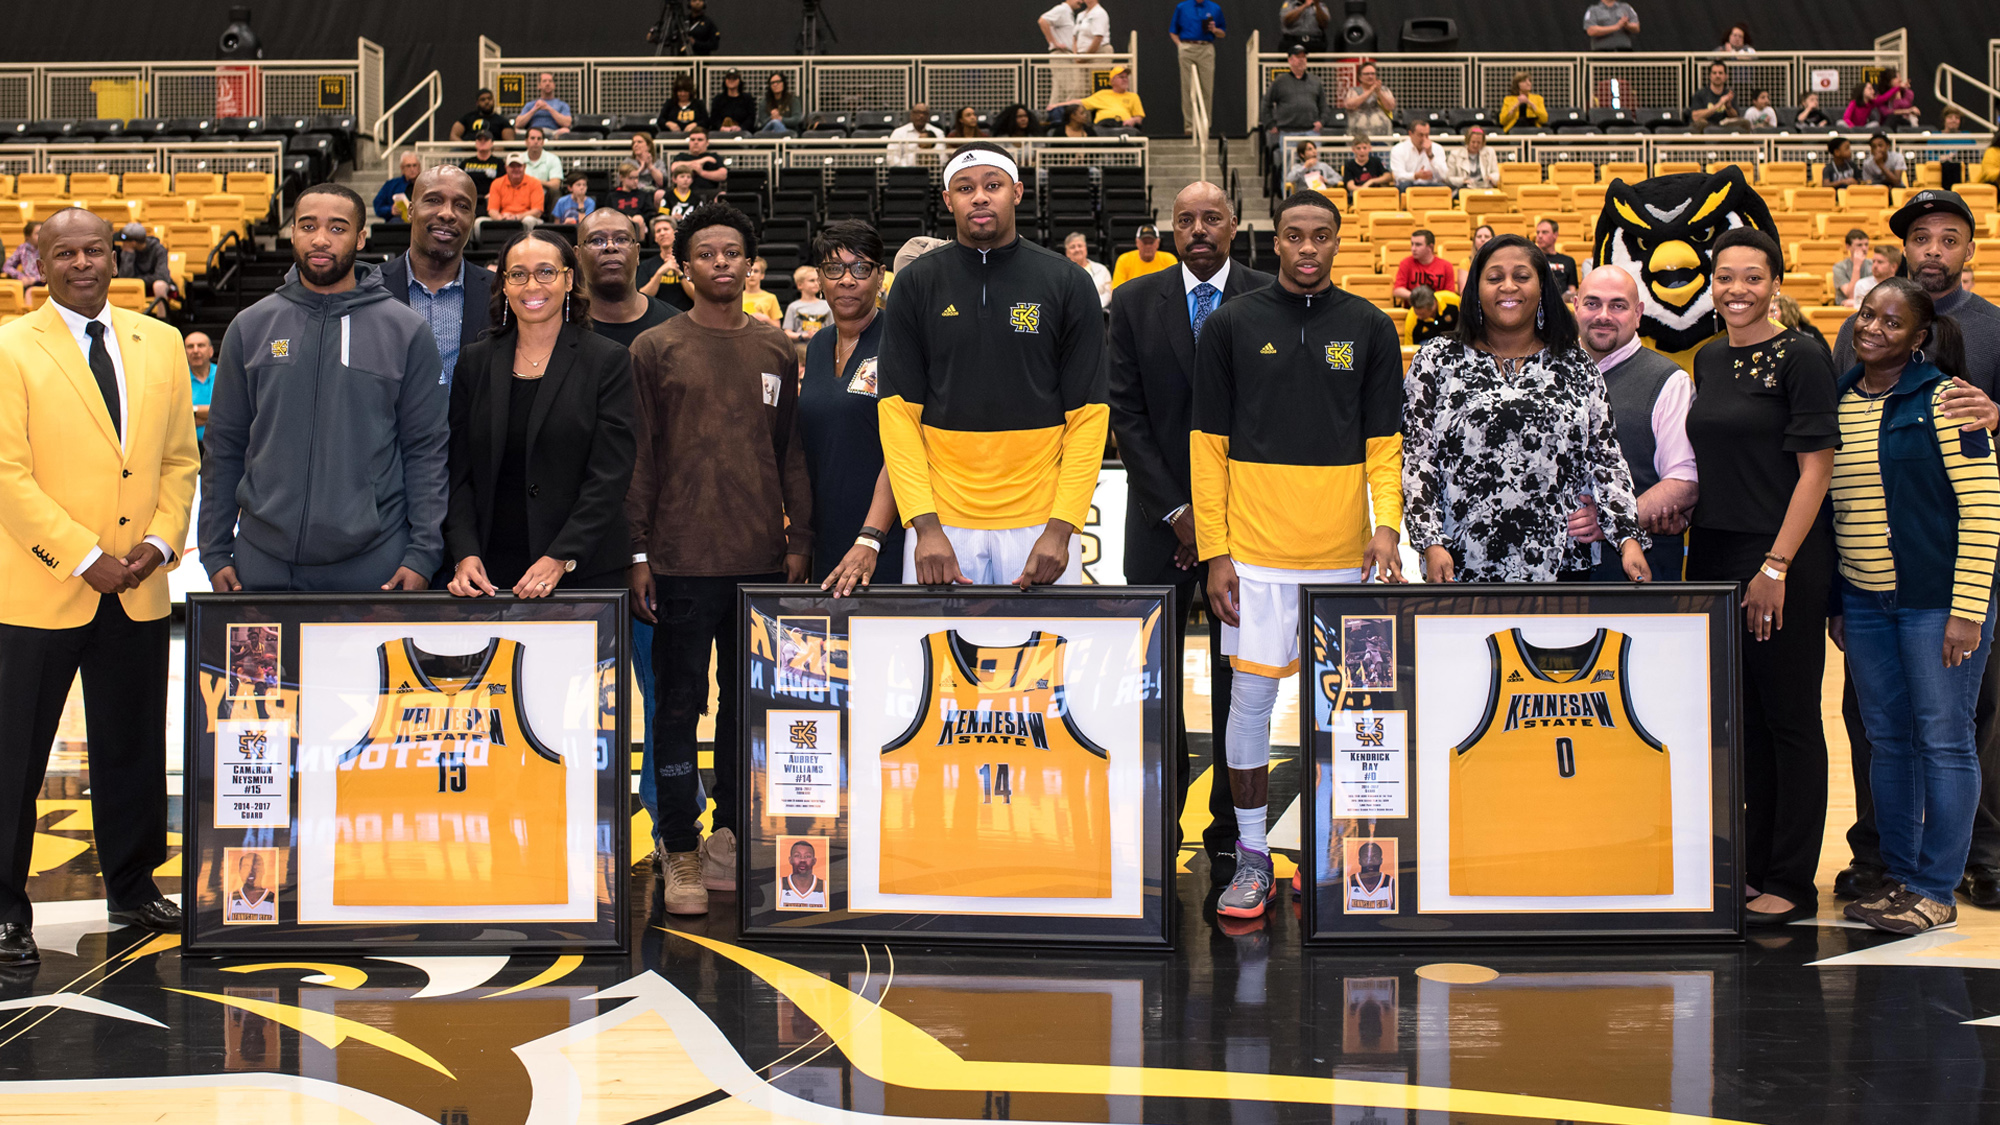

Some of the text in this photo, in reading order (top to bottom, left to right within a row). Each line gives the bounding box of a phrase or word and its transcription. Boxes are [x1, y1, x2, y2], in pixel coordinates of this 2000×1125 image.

[325, 85, 340, 94] 115
[503, 83, 519, 92] 114
[1411, 272, 1444, 289] JUST
[1501, 691, 1617, 734] KENNESAW
[394, 707, 508, 747] KENNESAW
[1524, 718, 1593, 728] STATE
[936, 709, 1051, 751] KENNESAW
[415, 733, 484, 742] STATE
[958, 735, 1027, 746] STATE
[788, 755, 819, 764] AUBREY
[1350, 752, 1390, 761] KENDRICK
[1555, 736, 1576, 778] 0
[233, 765, 272, 774] CAMERON
[784, 764, 823, 773] WILLIAMS
[1362, 762, 1379, 771] RAY
[437, 751, 467, 792] 15
[232, 775, 273, 784] NEYSMITH
[795, 774, 812, 783] #14
[1364, 772, 1377, 781] #0
[979, 763, 1012, 804] 14
[244, 785, 261, 794] #15
[241, 811, 263, 819] GUARD
